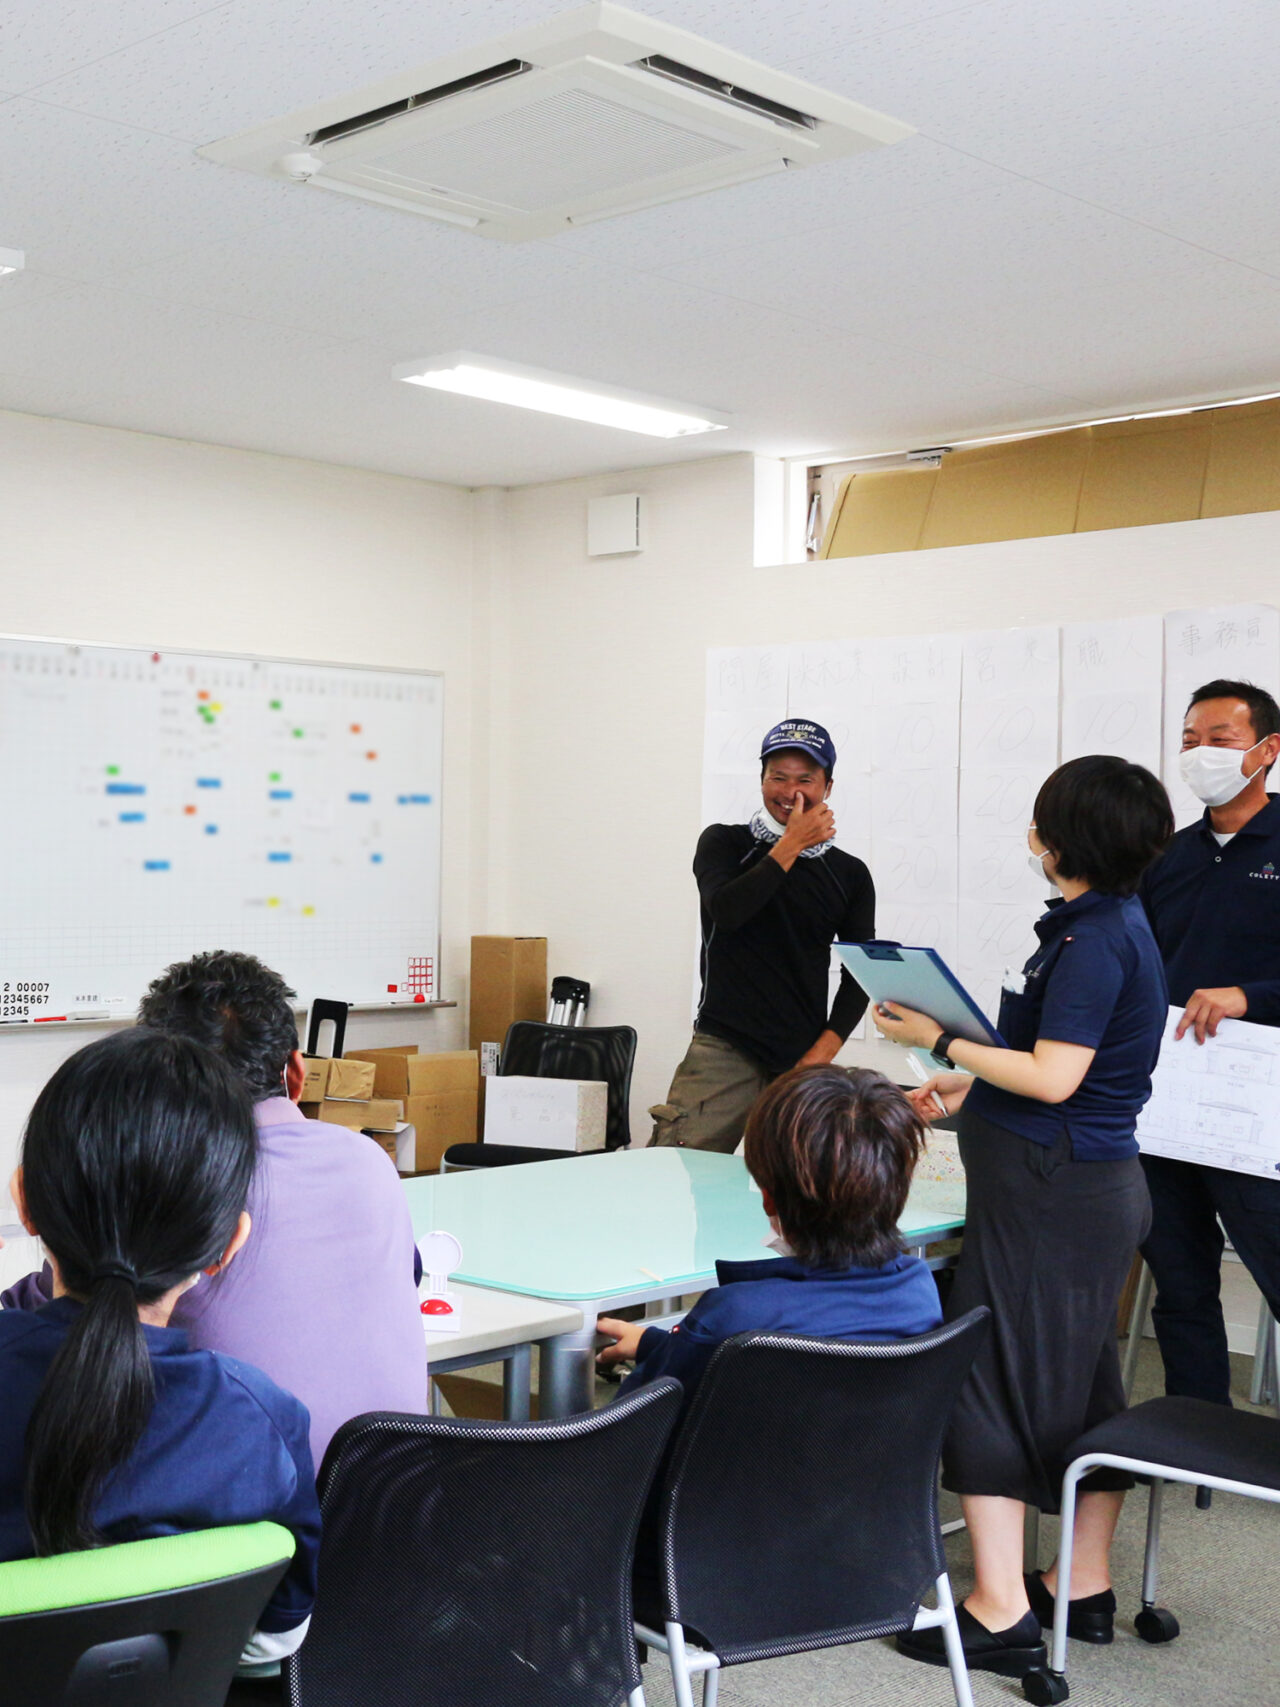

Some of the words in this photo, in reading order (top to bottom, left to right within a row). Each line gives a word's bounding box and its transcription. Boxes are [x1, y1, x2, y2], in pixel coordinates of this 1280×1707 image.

[1178, 615, 1267, 656] 事務員
[893, 715, 935, 755] 10
[976, 705, 1035, 752] 10
[1083, 700, 1138, 747] 10
[888, 780, 935, 828] 20
[975, 774, 1032, 824] 20
[976, 908, 1033, 956] 40
[4, 983, 10, 992] 2
[17, 983, 50, 992] 00007
